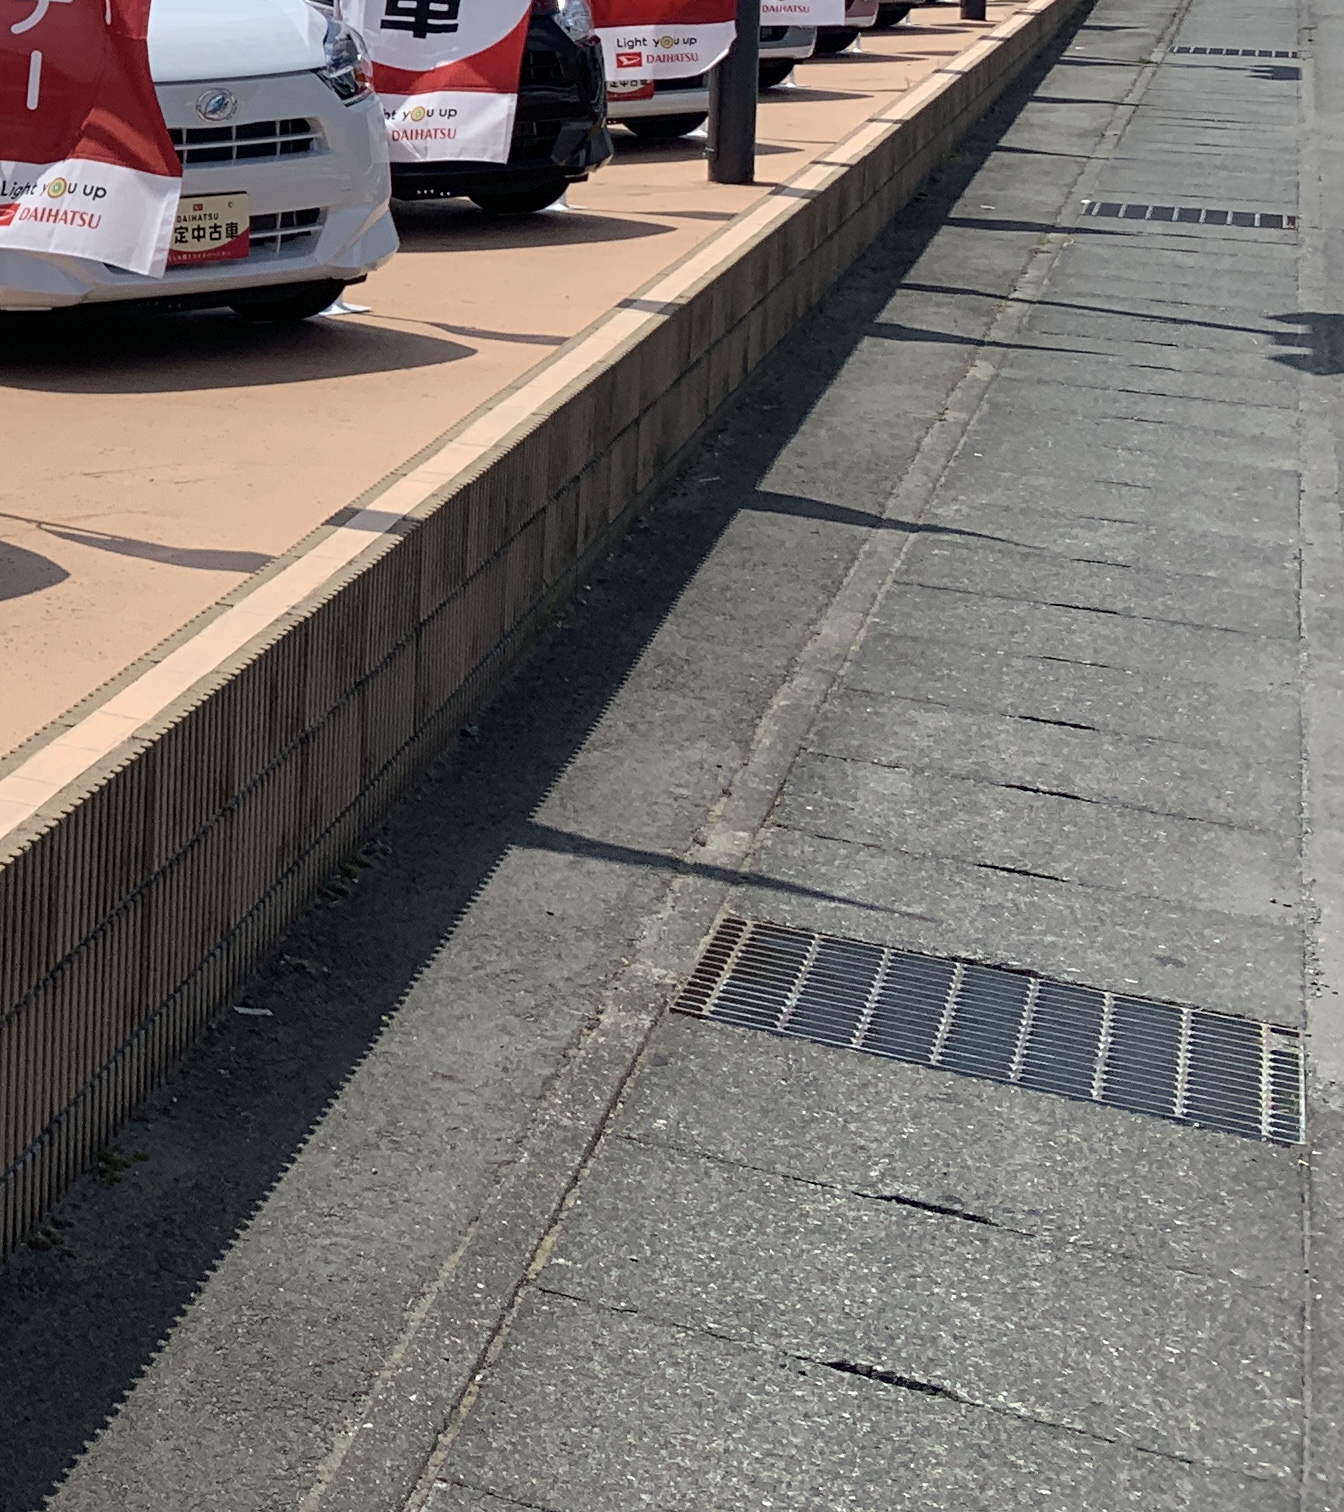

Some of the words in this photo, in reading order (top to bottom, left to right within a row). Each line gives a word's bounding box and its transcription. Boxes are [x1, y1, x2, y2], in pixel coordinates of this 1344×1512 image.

[762, 5, 810, 14] DAIHATSU
[617, 37, 647, 49] Light
[683, 37, 697, 46] up
[646, 53, 699, 64] DAIHATSU
[439, 108, 457, 120] up
[392, 128, 457, 142] DAIHATSU
[0, 180, 37, 199] Light
[83, 185, 107, 200] up
[18, 207, 102, 229] DAIHATSU
[176, 213, 219, 224] DAIHATSU
[174, 222, 239, 243] 定中古車
